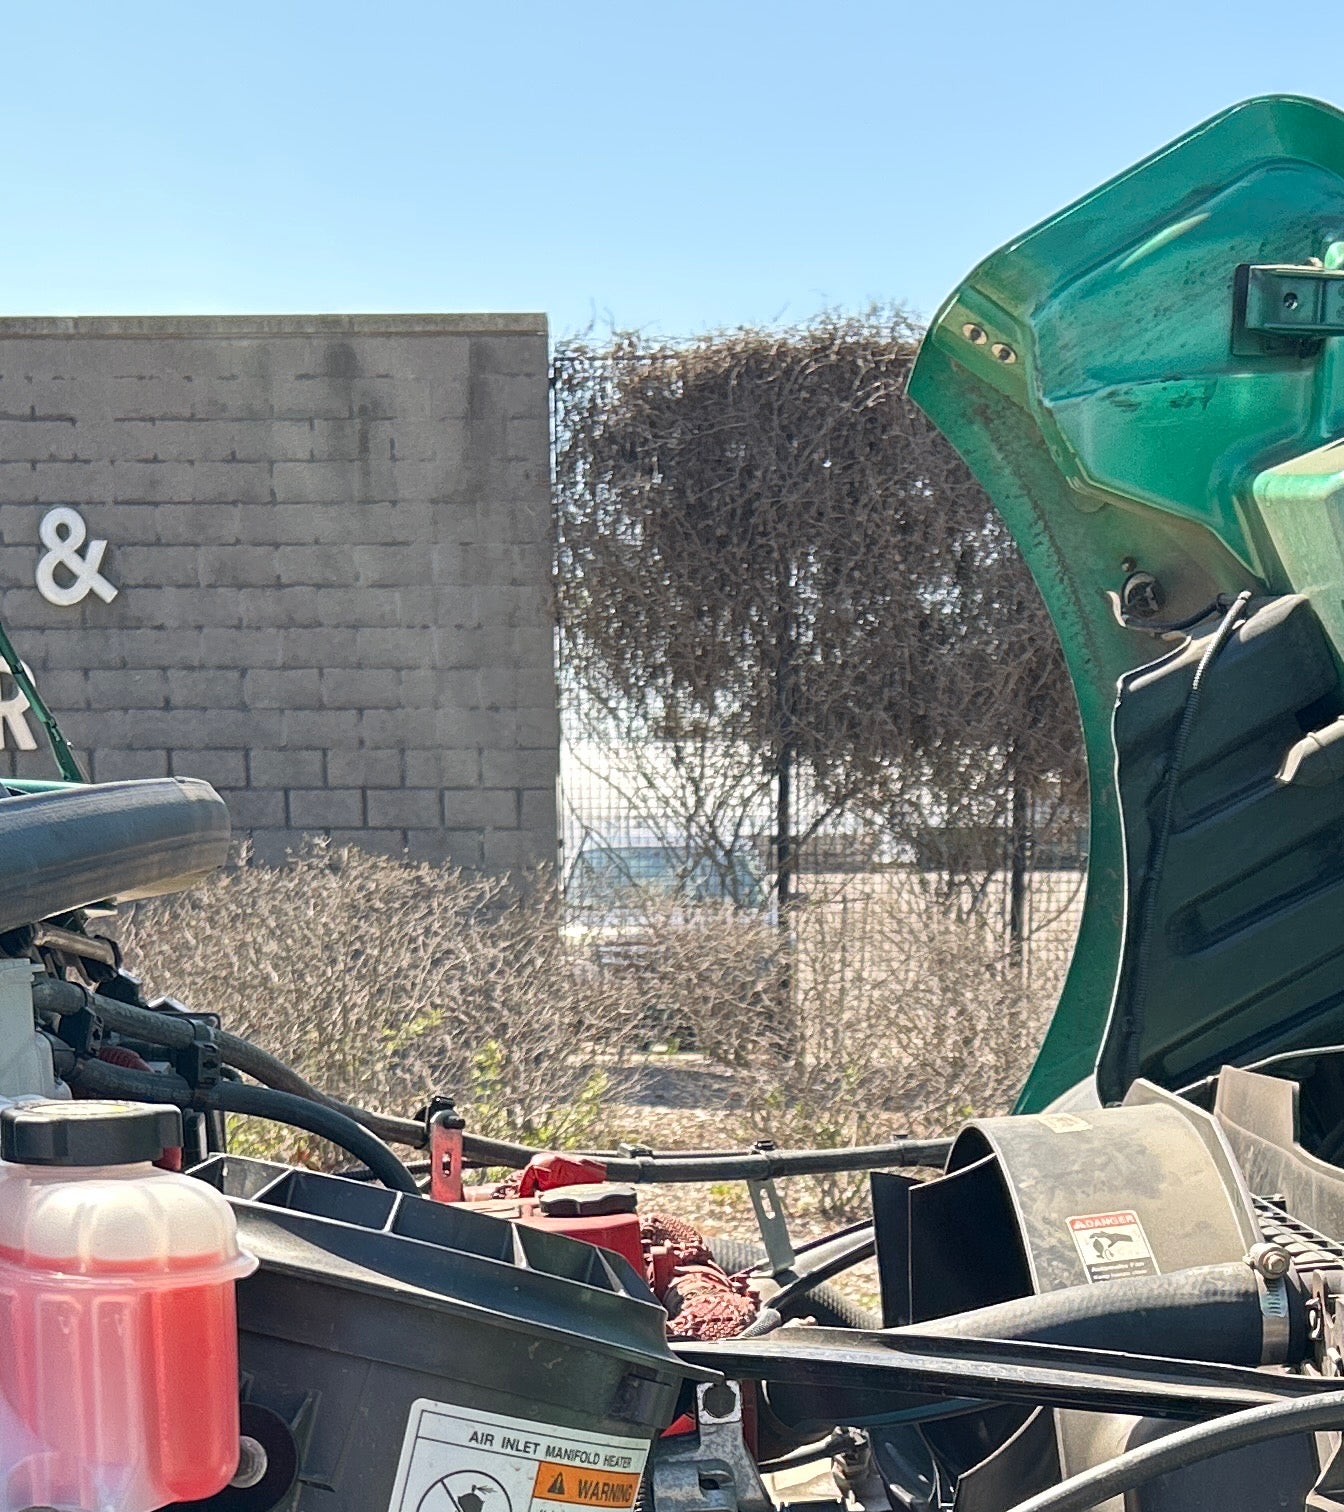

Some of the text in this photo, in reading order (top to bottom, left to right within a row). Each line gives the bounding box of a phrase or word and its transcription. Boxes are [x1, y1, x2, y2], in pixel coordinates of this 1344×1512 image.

[36, 507, 118, 606] &
[1086, 1215, 1135, 1227] DANGER
[469, 1431, 632, 1468] AIR INLET MANIFOLD HEATER
[578, 1479, 633, 1503] WARNING
